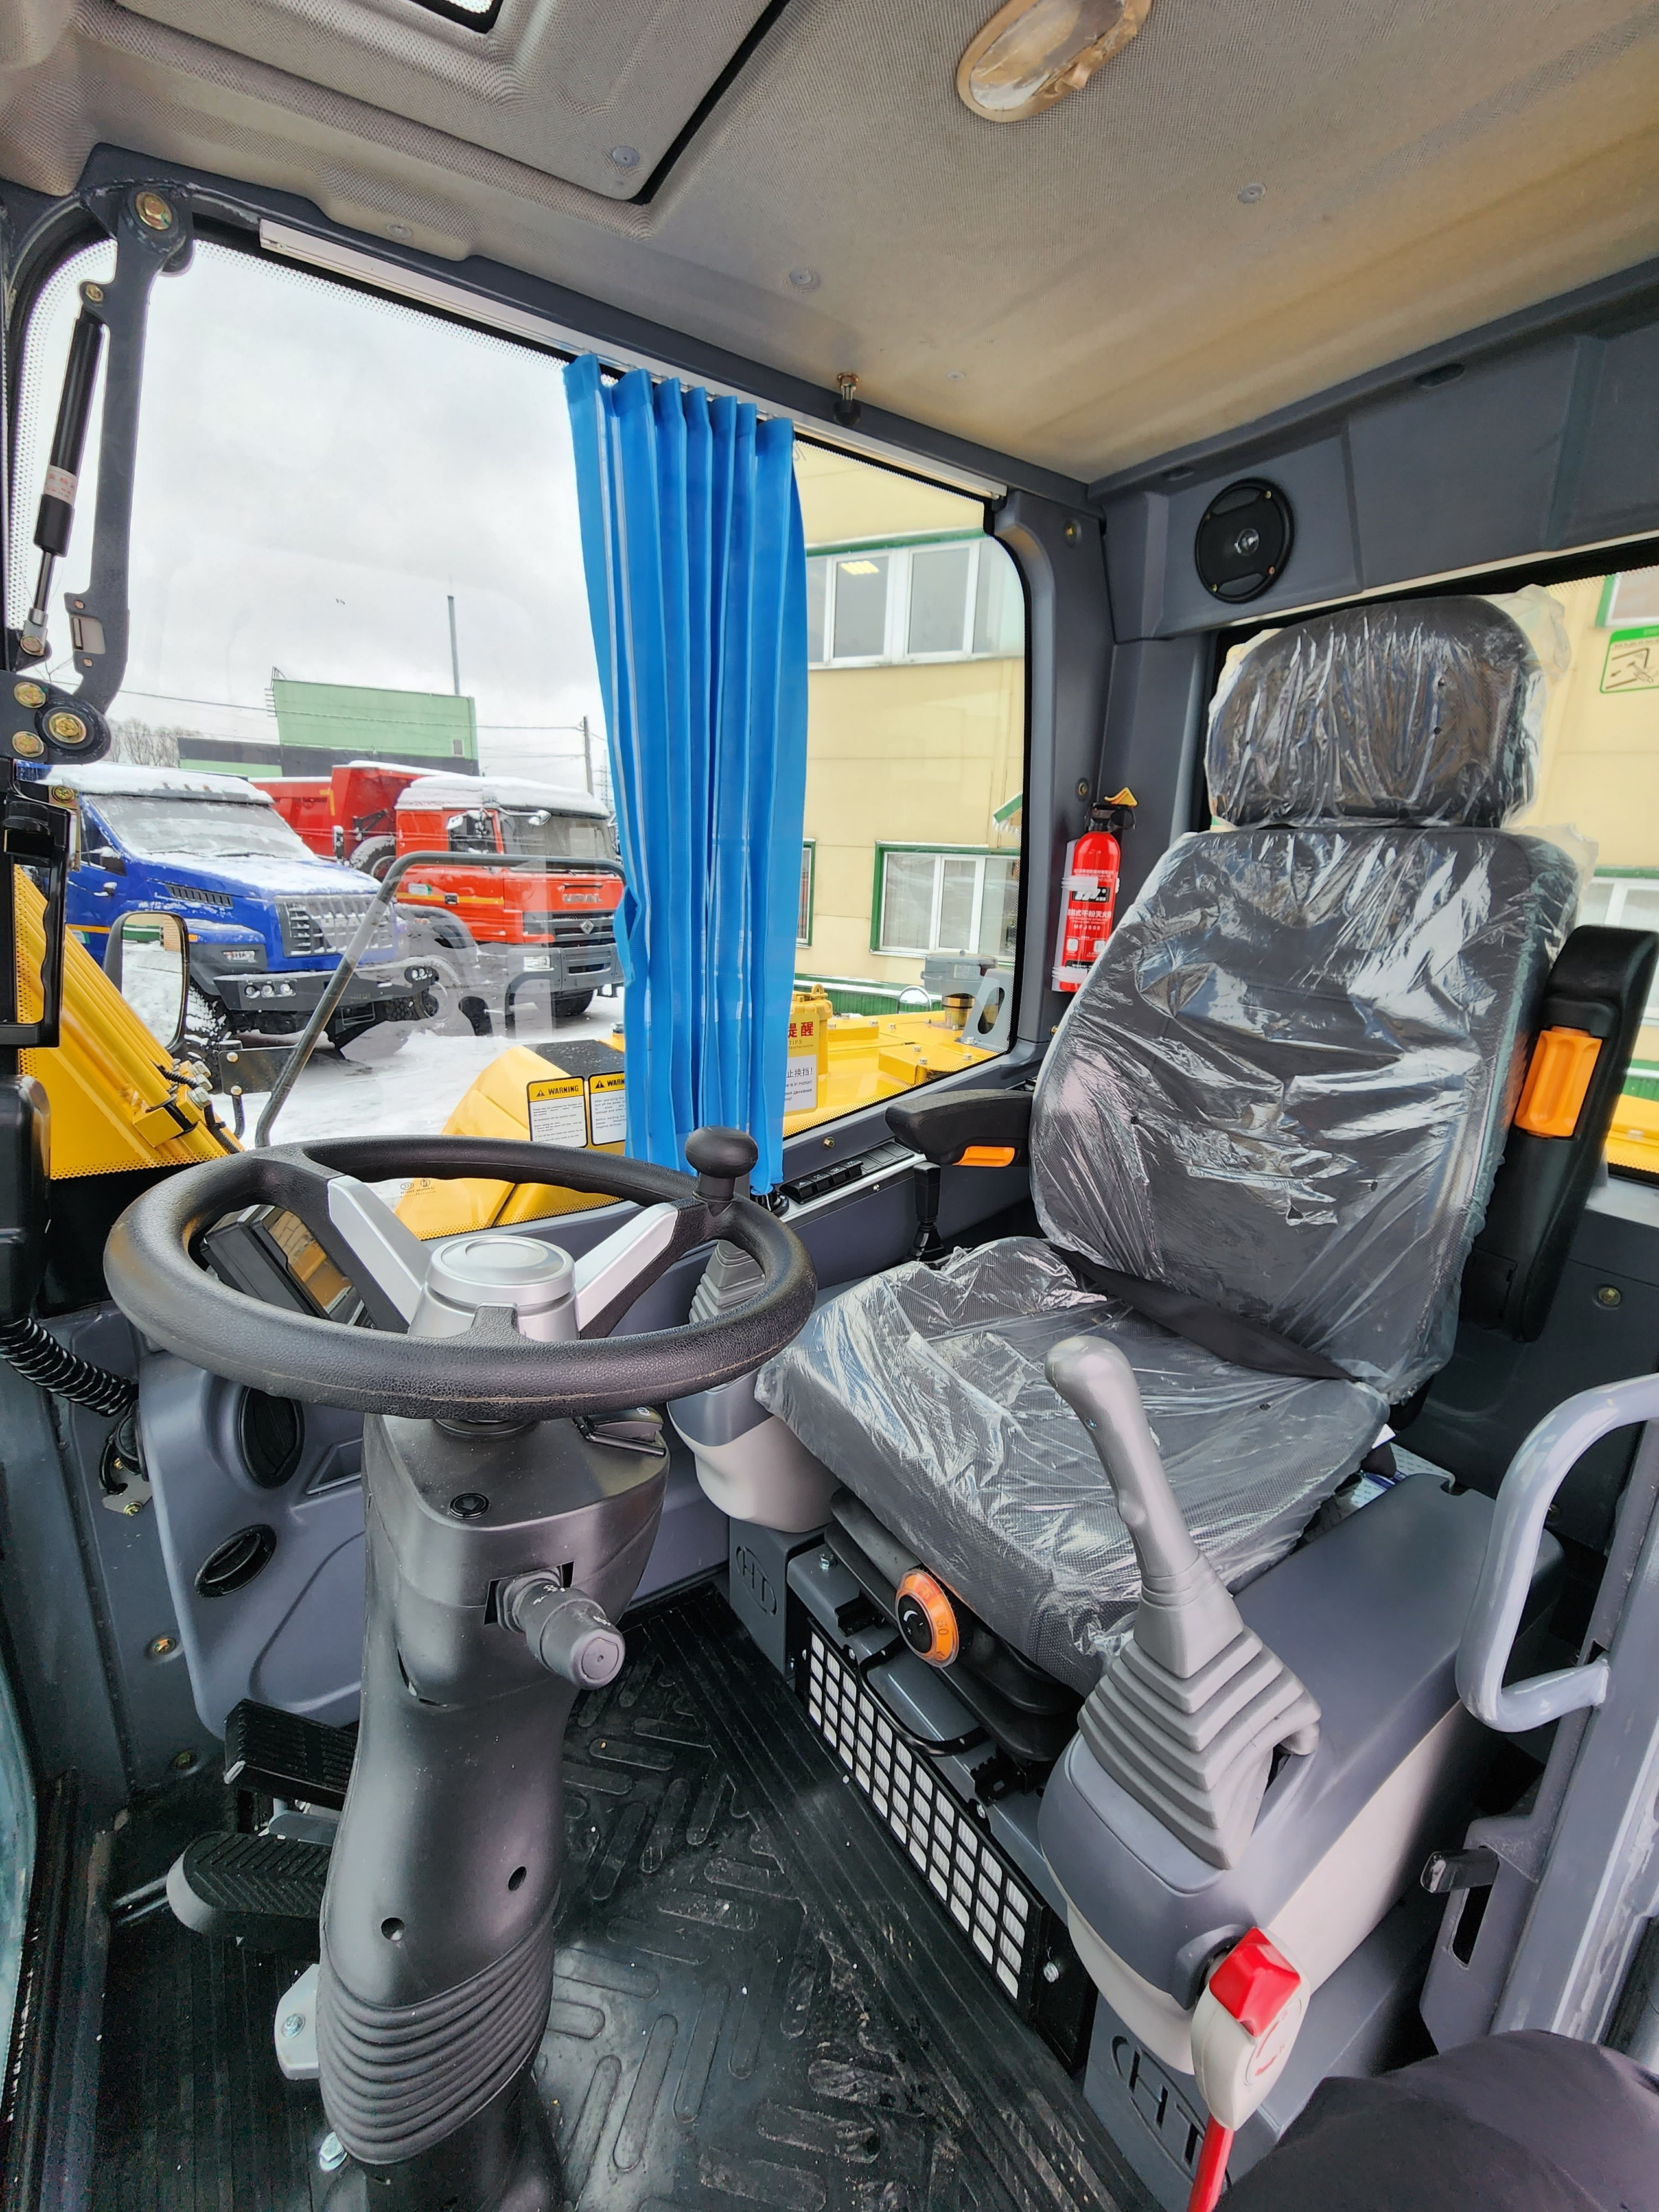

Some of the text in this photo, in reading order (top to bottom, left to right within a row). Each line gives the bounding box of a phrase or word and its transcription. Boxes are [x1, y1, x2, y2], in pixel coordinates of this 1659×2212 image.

[563, 894, 603, 903] URAL
[548, 1085, 579, 1095] WARNING
[936, 1620, 949, 1636] 50
